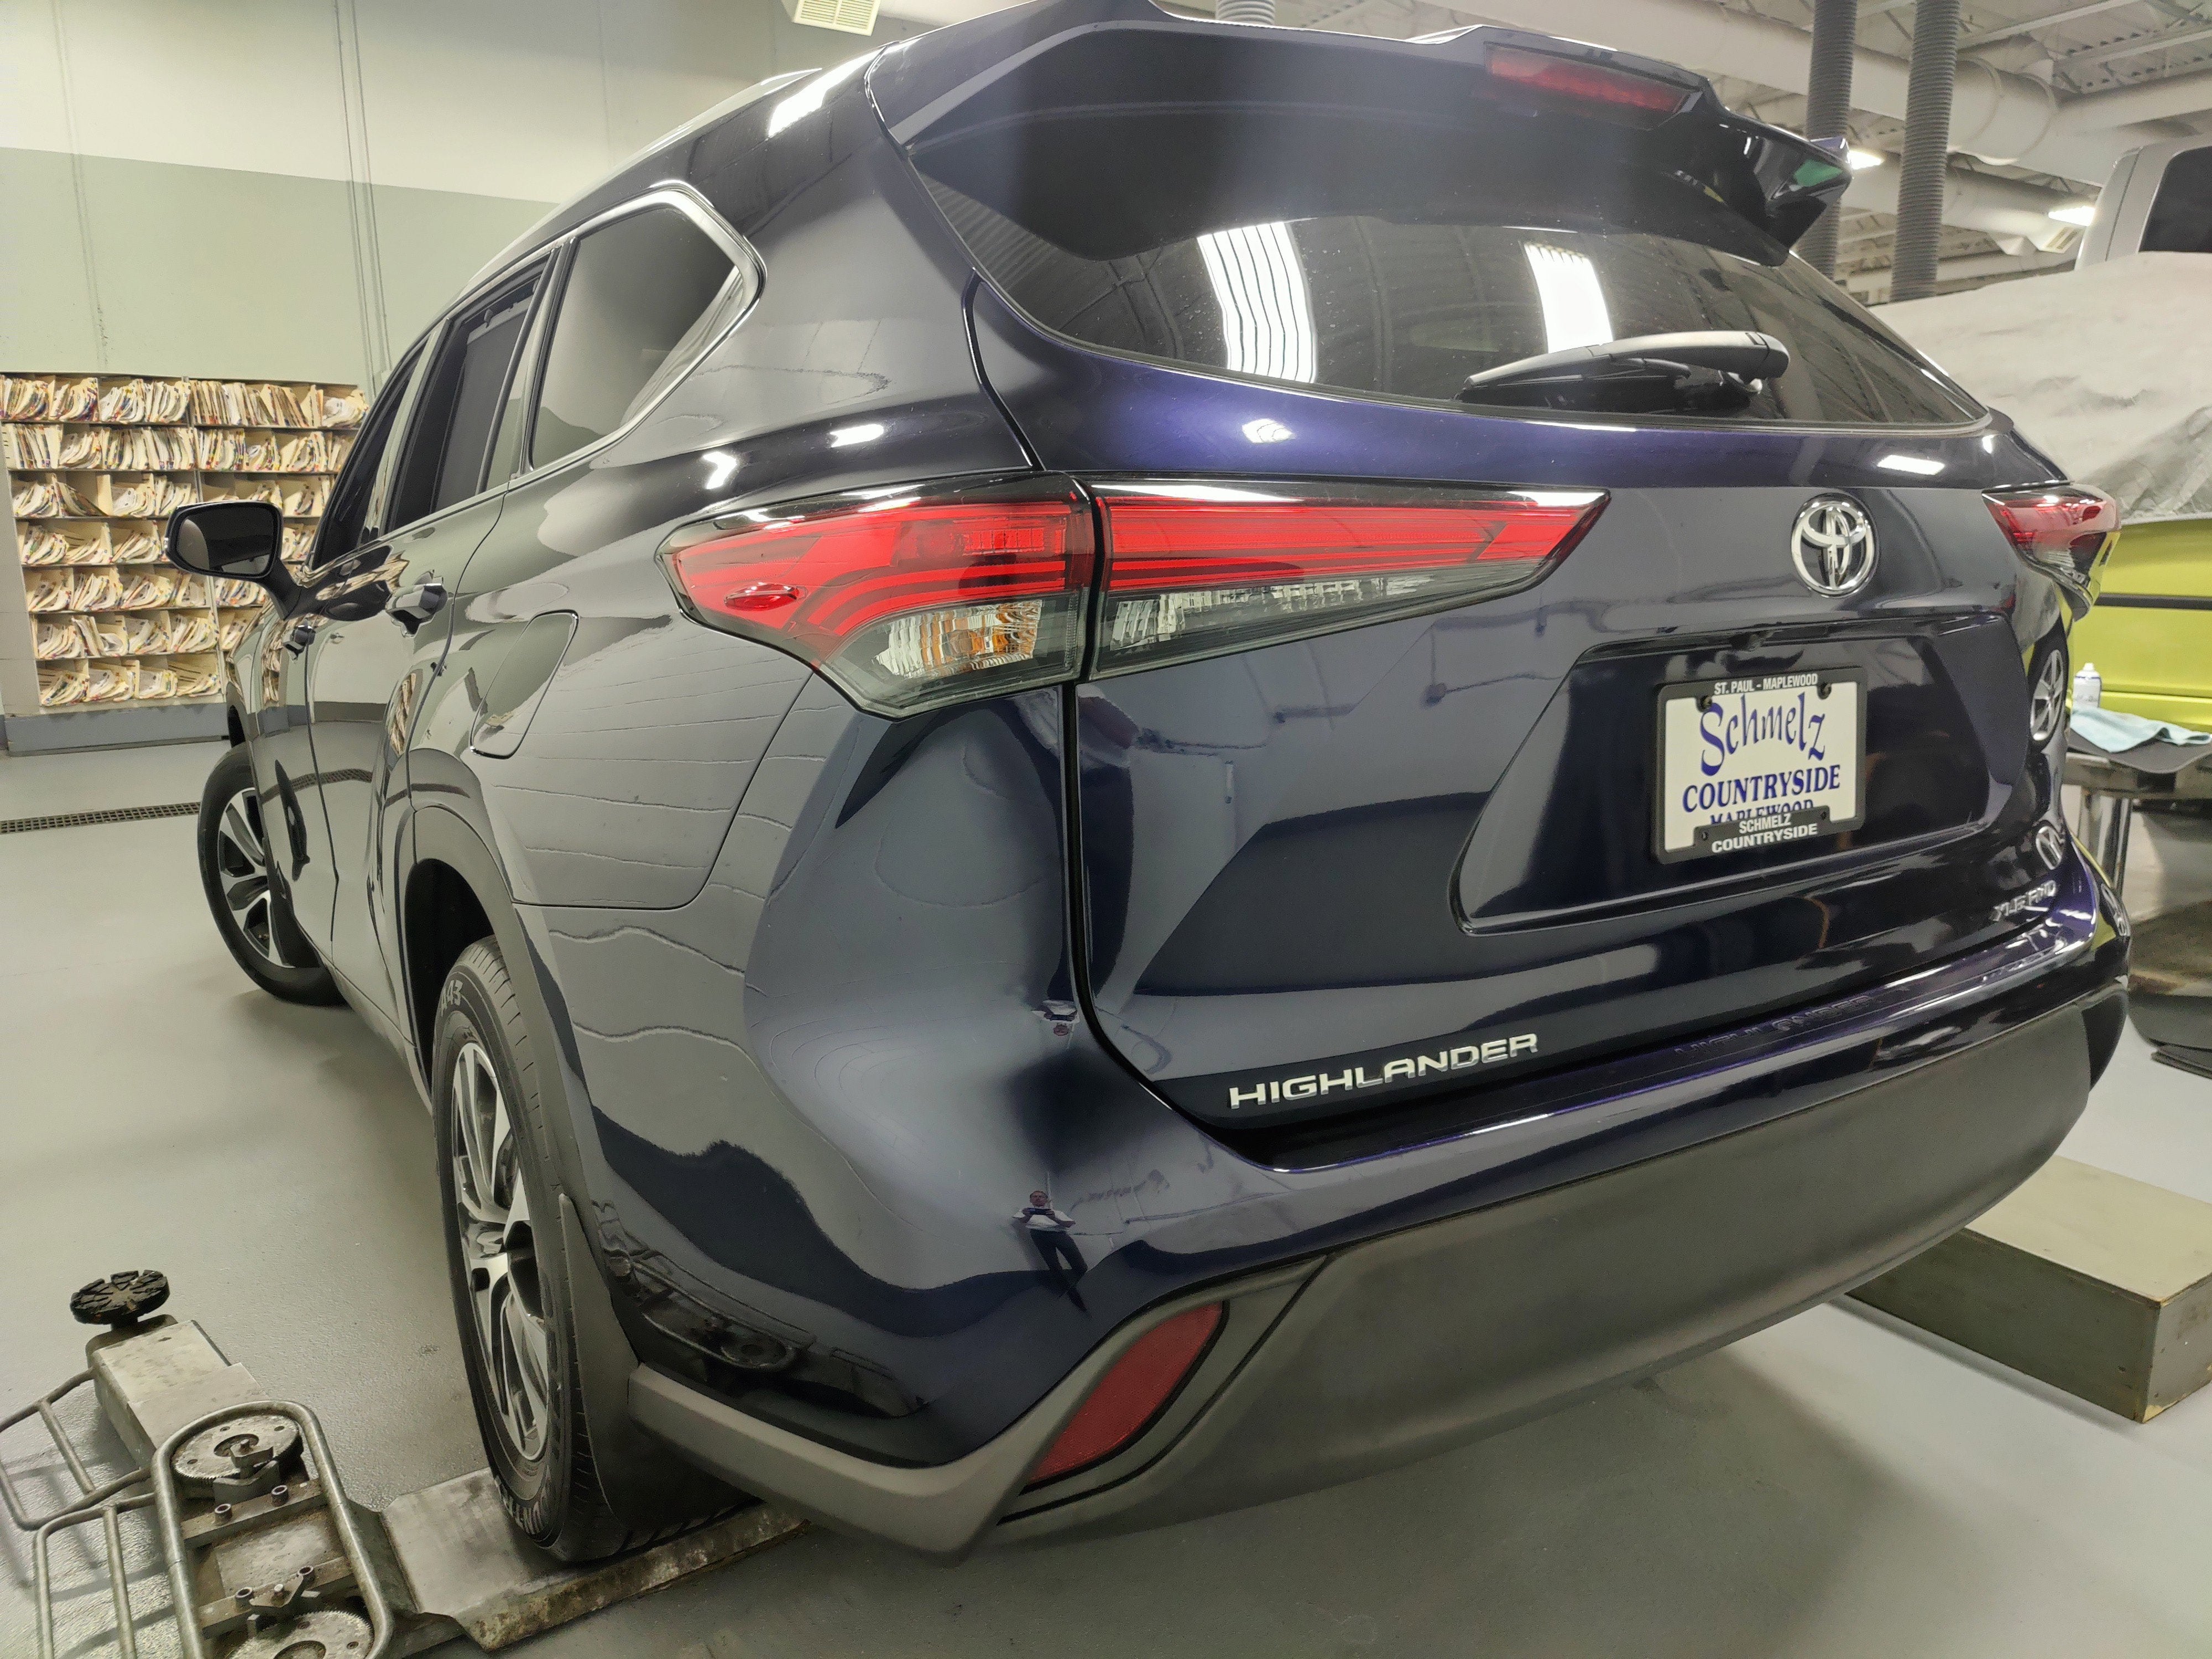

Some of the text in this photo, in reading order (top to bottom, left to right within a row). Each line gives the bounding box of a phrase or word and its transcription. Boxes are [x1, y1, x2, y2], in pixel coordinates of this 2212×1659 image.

[1714, 682, 1729, 695] ST.
[1730, 680, 1755, 693] PAUL
[1762, 673, 1818, 690] MAPLEWOOD
[1699, 691, 1826, 776] Schmelz
[1682, 764, 1840, 813] COUNTRYSIDE
[1712, 823, 1818, 853] COUNTRYSIDE
[1739, 813, 1792, 834] SCHMELZ
[1228, 1033, 1539, 1109] HIGHLANDER
